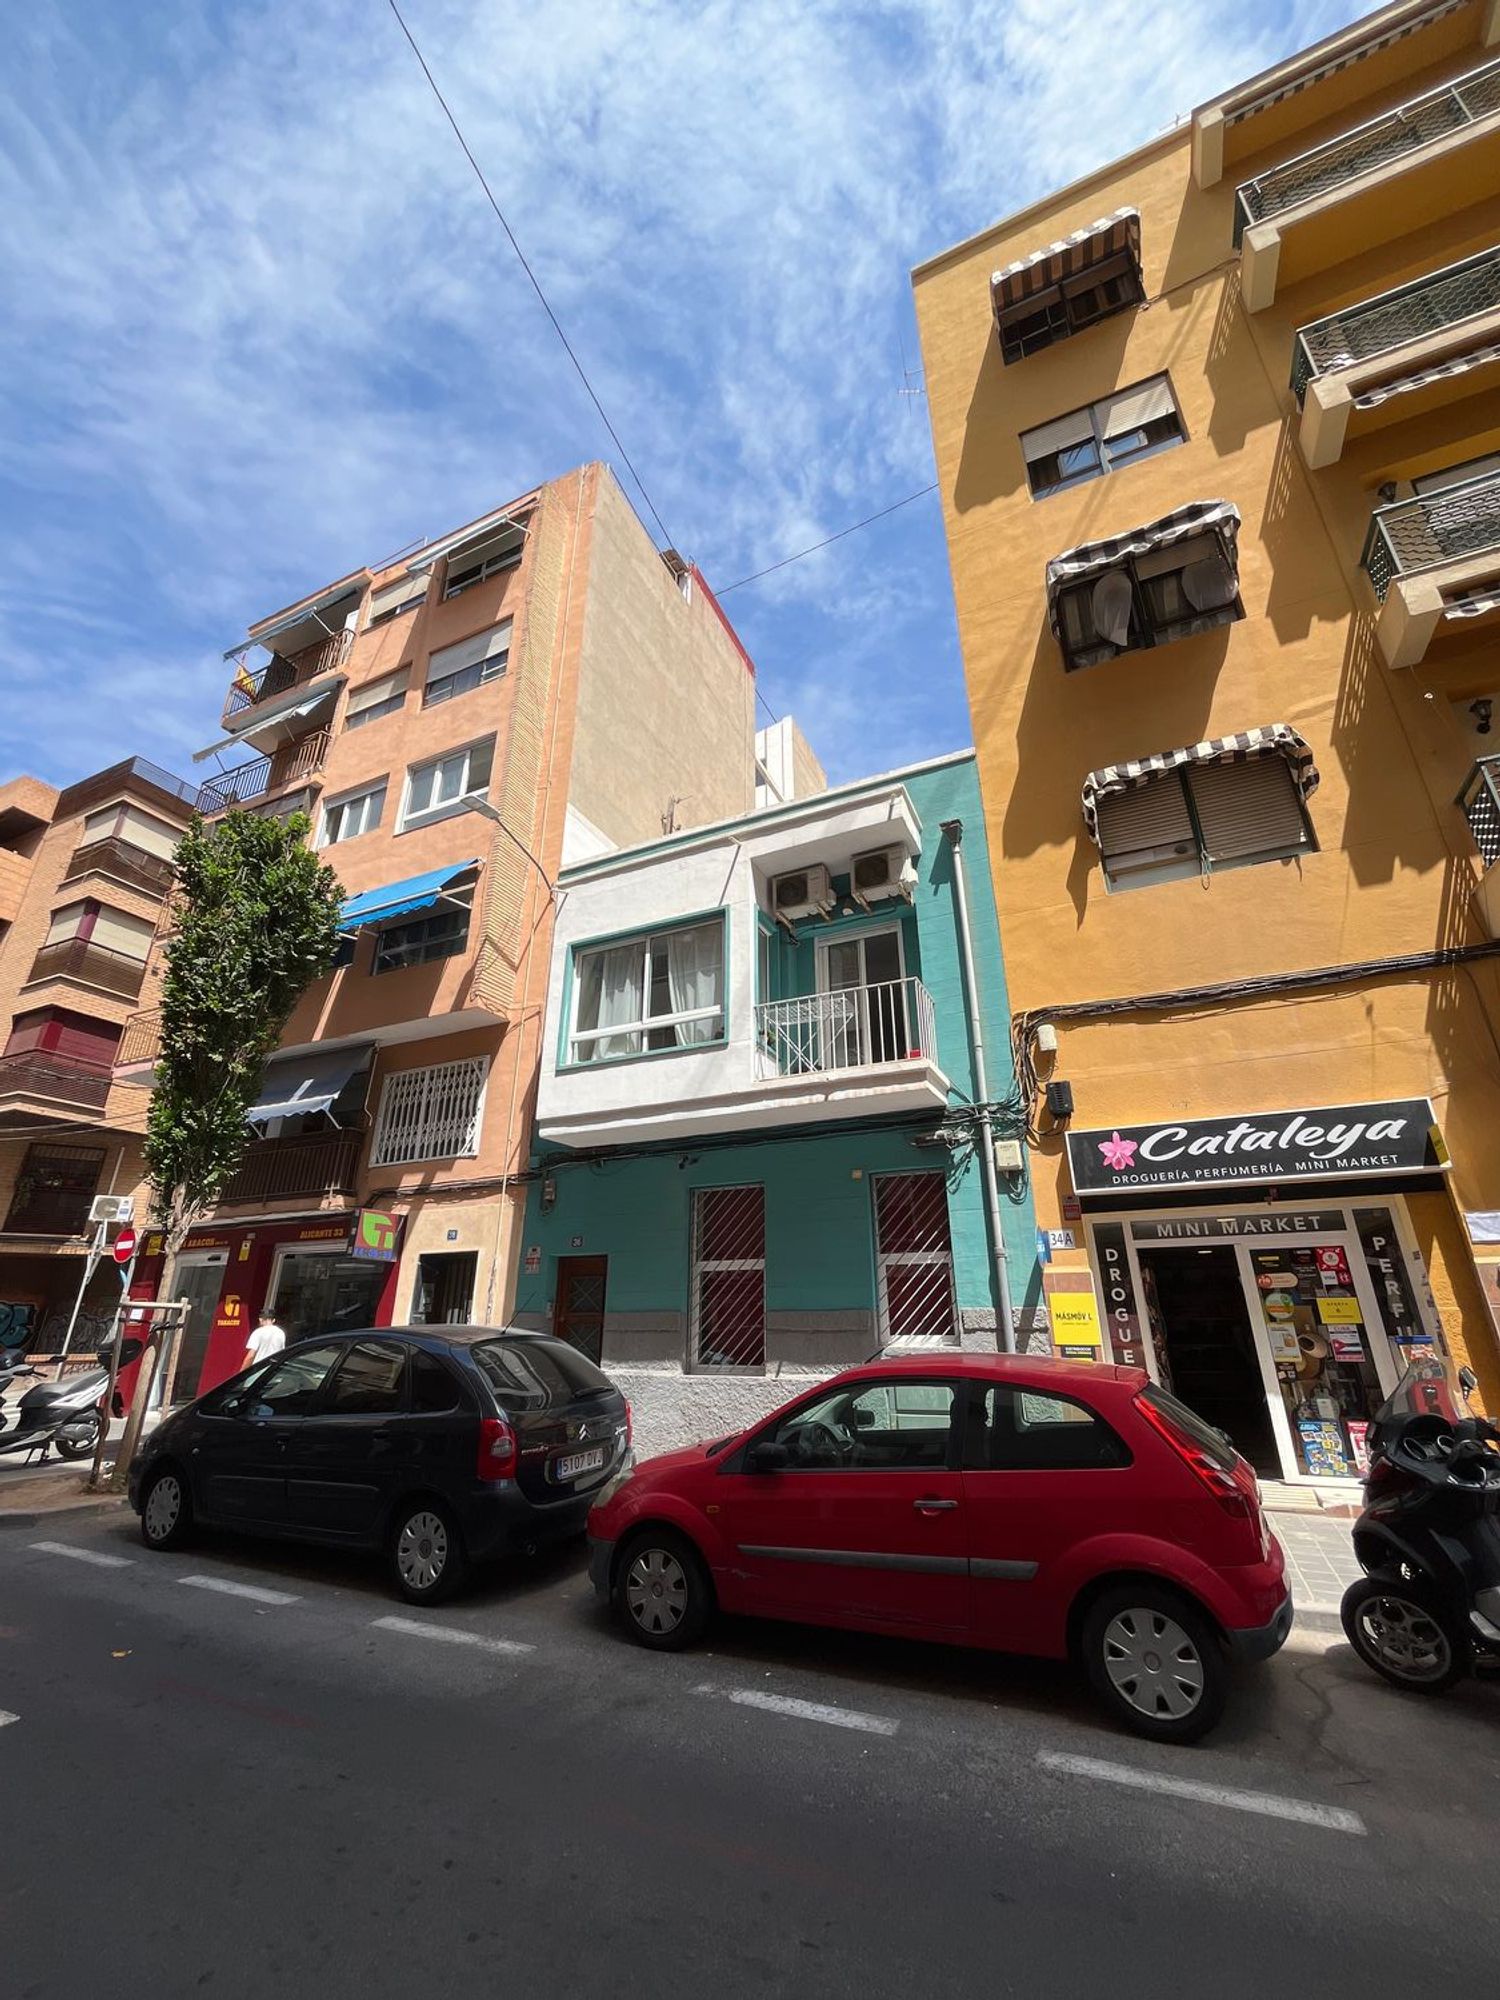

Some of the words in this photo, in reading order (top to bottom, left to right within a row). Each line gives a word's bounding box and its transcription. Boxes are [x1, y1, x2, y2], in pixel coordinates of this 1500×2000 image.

[1138, 1116, 1408, 1161] Cataleya
[1112, 1169, 1190, 1184] DROGUERÍA
[1195, 1162, 1284, 1181] PERFUMERÍA
[1295, 1160, 1330, 1172] MINI
[1336, 1154, 1400, 1169] MARKET
[1157, 1222, 1209, 1238] MINI
[1219, 1215, 1321, 1233] MARKET
